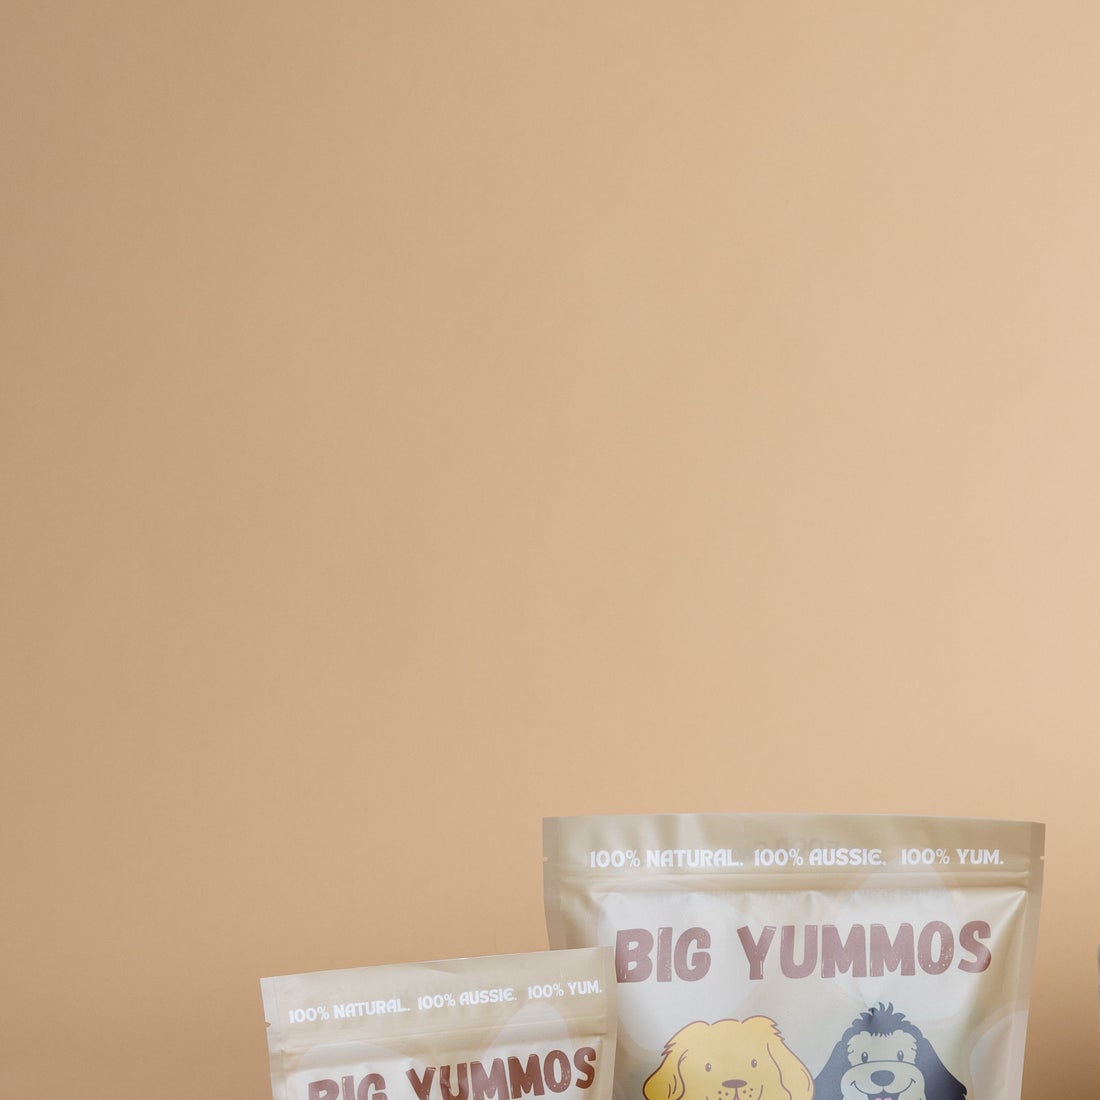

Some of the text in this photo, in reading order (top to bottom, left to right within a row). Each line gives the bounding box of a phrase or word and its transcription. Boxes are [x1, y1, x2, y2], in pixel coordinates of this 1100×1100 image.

[590, 848, 1004, 868] 100% NATURAL. 100% AUSSIE. 100% YUM.
[615, 920, 992, 983] BIG YUMMOS
[288, 980, 603, 1024] 100% NATURAL. 100% AUSSIE. 100% YUM.
